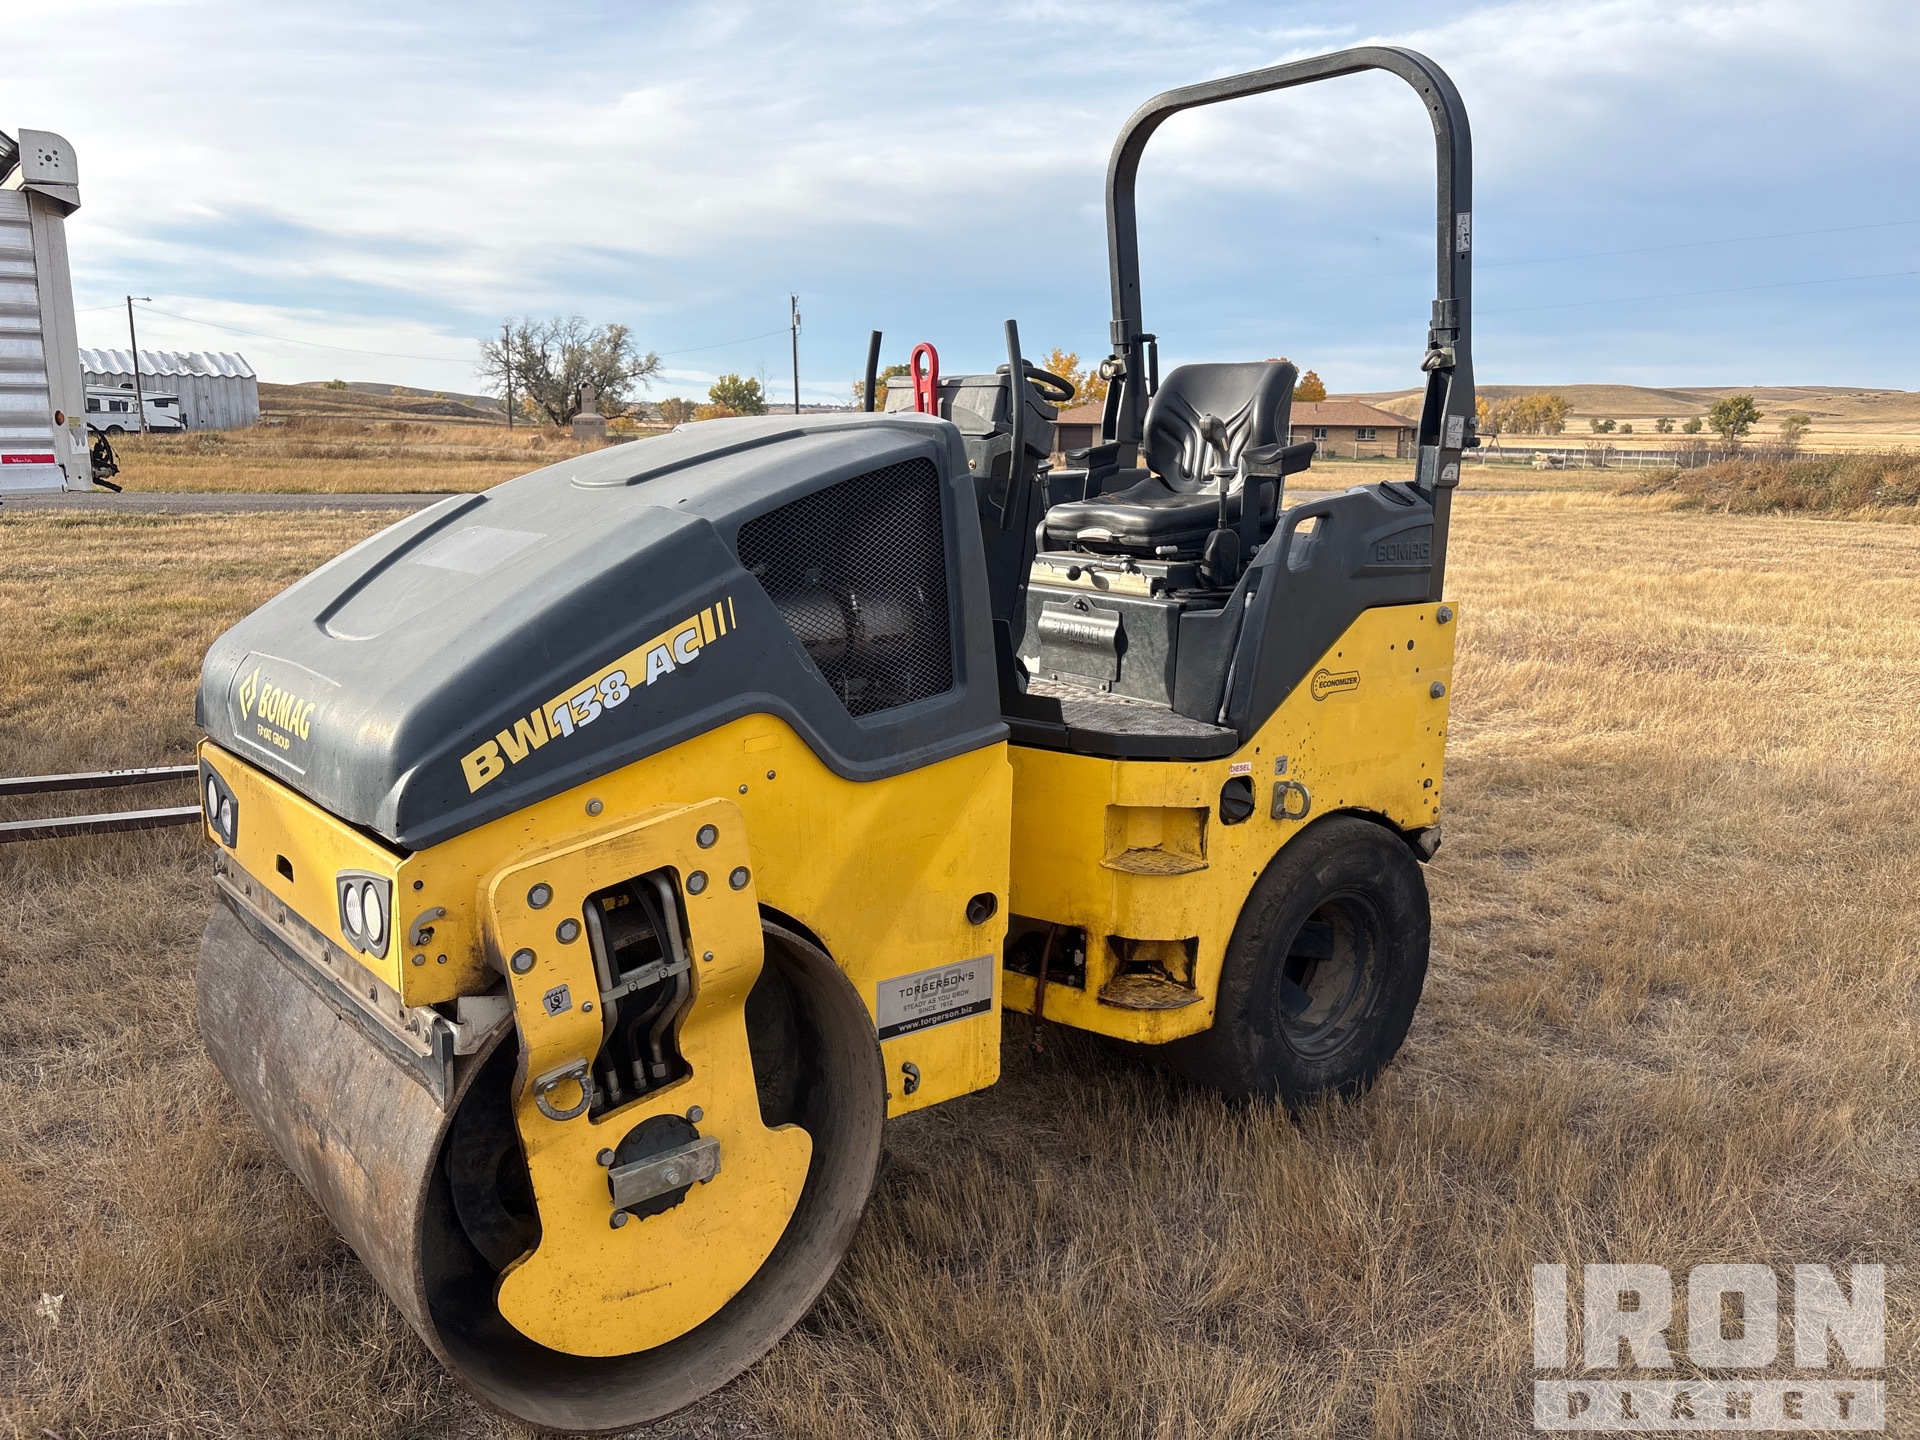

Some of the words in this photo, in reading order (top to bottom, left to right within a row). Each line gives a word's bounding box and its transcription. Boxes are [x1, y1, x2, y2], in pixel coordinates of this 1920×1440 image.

[1376, 541, 1430, 562] BOMAG
[1319, 677, 1358, 688] ECONOMIZER
[257, 682, 316, 741] BOMAG
[272, 731, 290, 751] GROUP
[1230, 764, 1251, 773] DIESEL
[898, 971, 975, 998] TORGERSON'S
[903, 1001, 927, 1012] STEADY
[927, 997, 937, 1005] AS
[937, 993, 951, 1002] YOU
[951, 988, 970, 998] GROW
[918, 1004, 937, 1015] SINCE
[940, 999, 954, 1009] 1912
[898, 1005, 973, 1032] www.torgerson.biz
